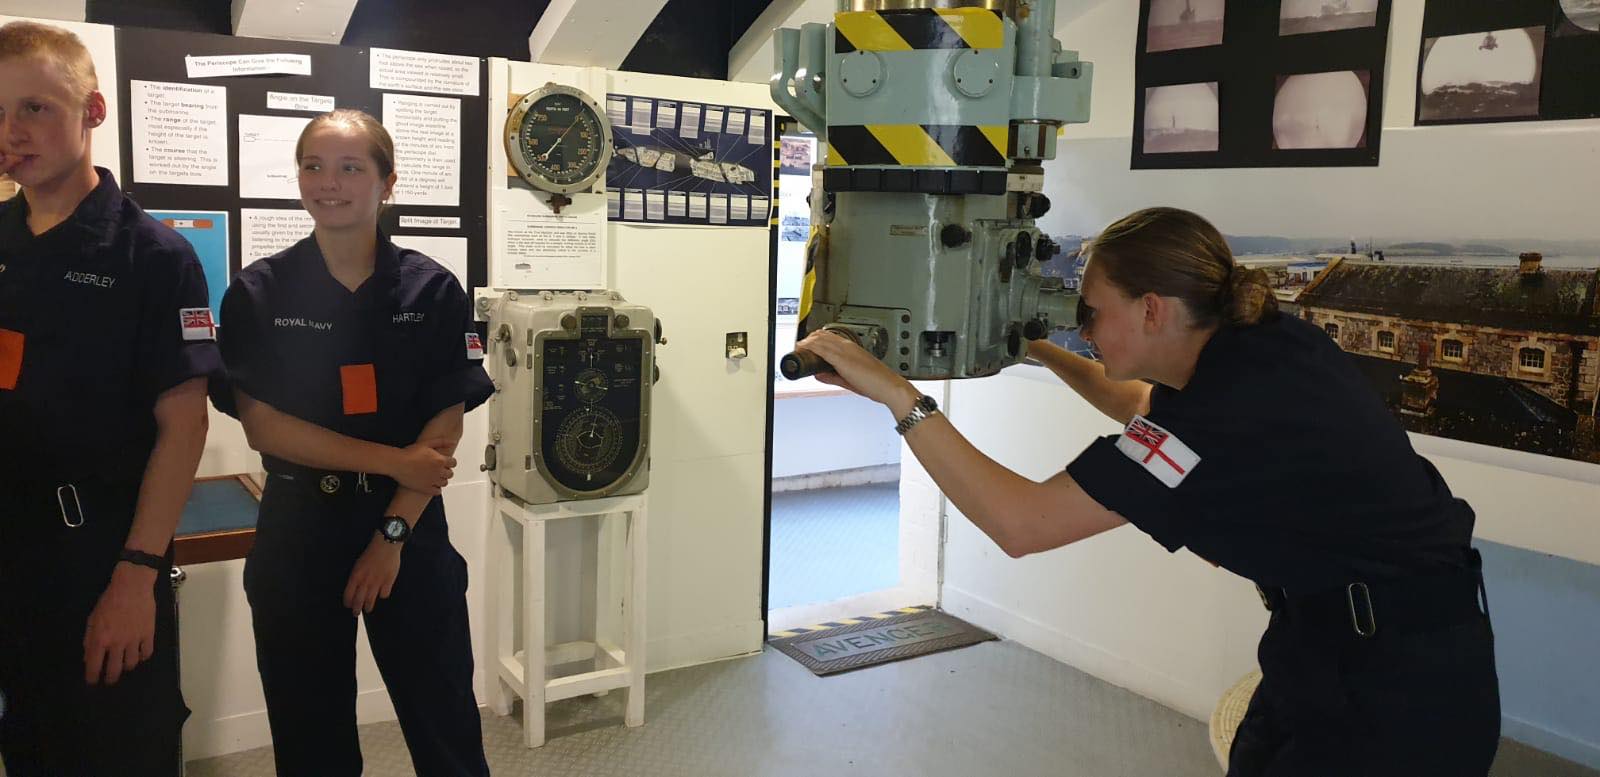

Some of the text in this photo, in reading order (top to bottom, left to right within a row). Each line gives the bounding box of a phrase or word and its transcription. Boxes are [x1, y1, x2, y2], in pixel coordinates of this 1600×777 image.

[64, 271, 116, 288] ADDERLEY
[274, 317, 333, 331] ROYAL NAVY
[393, 312, 424, 323] HARTLEY
